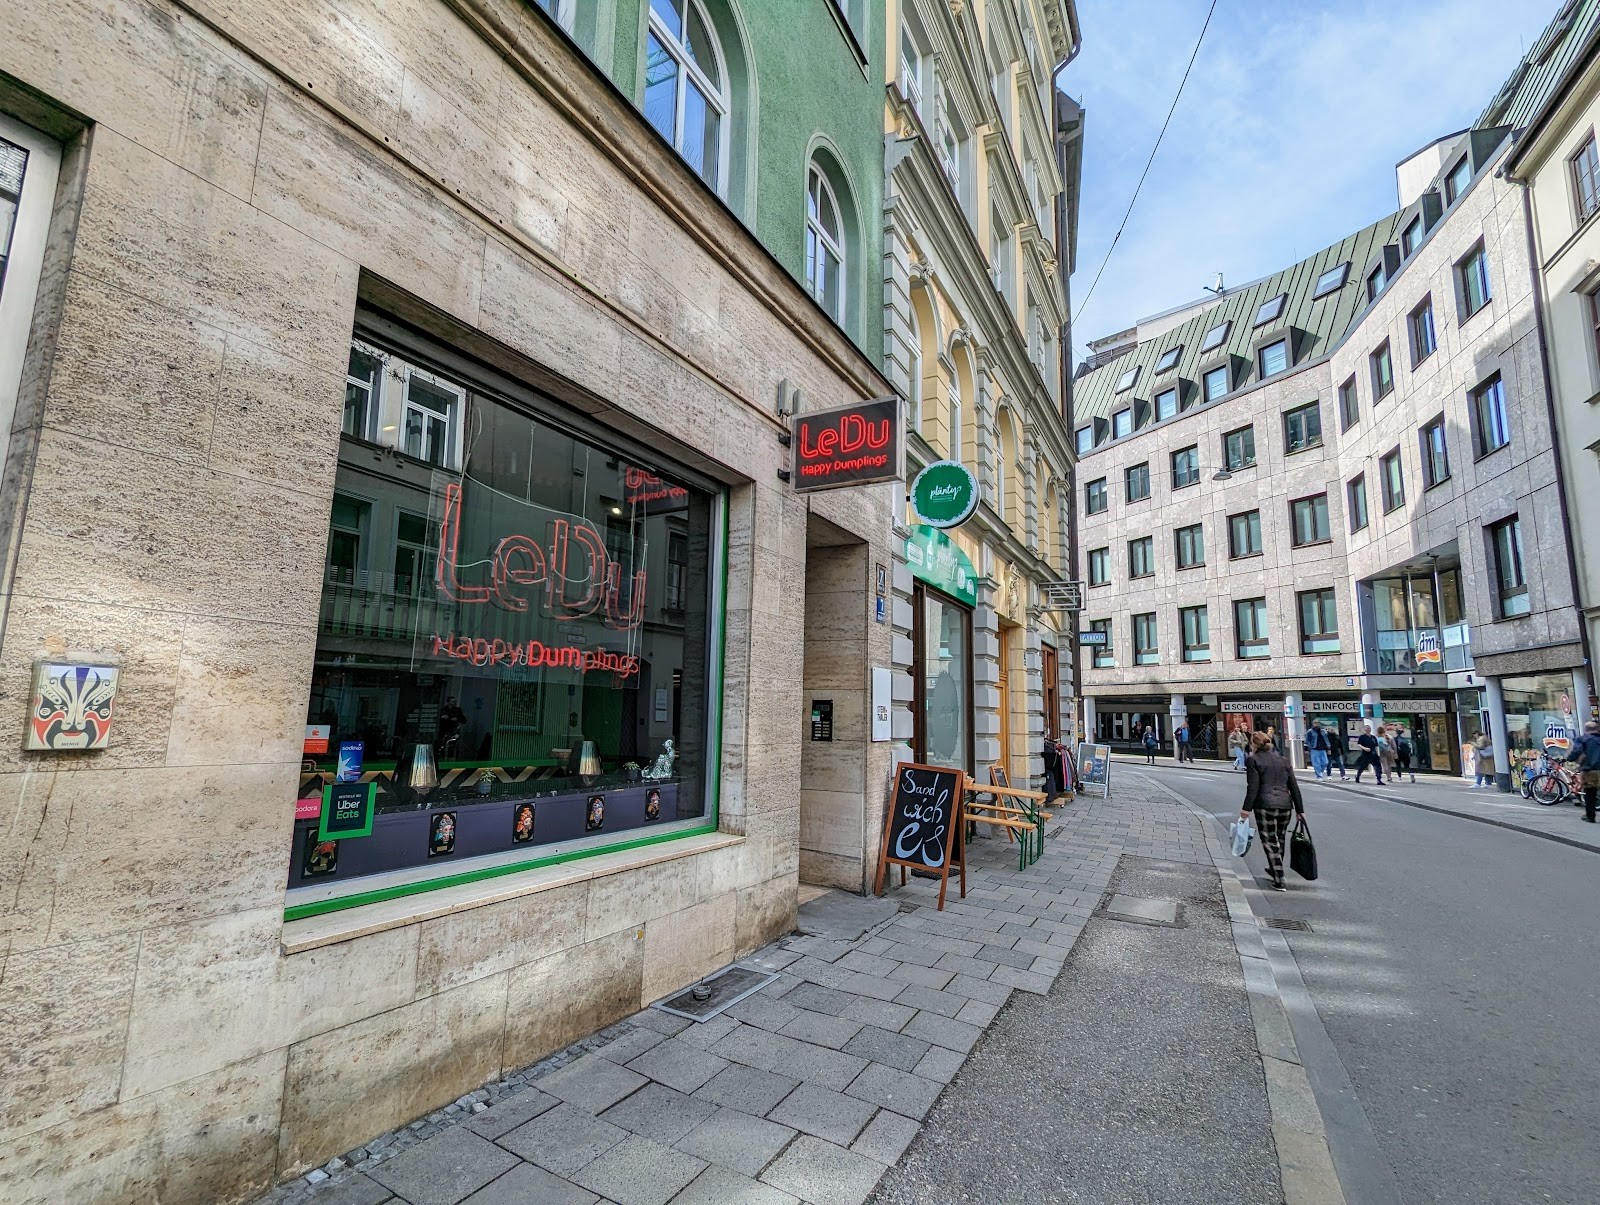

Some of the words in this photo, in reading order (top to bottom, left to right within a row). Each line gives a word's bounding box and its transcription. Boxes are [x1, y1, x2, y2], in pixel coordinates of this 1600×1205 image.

[801, 414, 889, 459] LeDu
[801, 462, 832, 475] Happy
[834, 454, 888, 470] Dumplings
[438, 484, 647, 631] LeDu
[1419, 633, 1435, 652] dm
[433, 632, 520, 667] Happy
[527, 639, 641, 679] Dumplings
[1547, 723, 1564, 739] dm
[901, 769, 939, 796] Sand
[295, 805, 318, 813] oodora
[336, 810, 360, 820] Eats
[337, 800, 361, 810] Uber
[903, 789, 949, 823] wich
